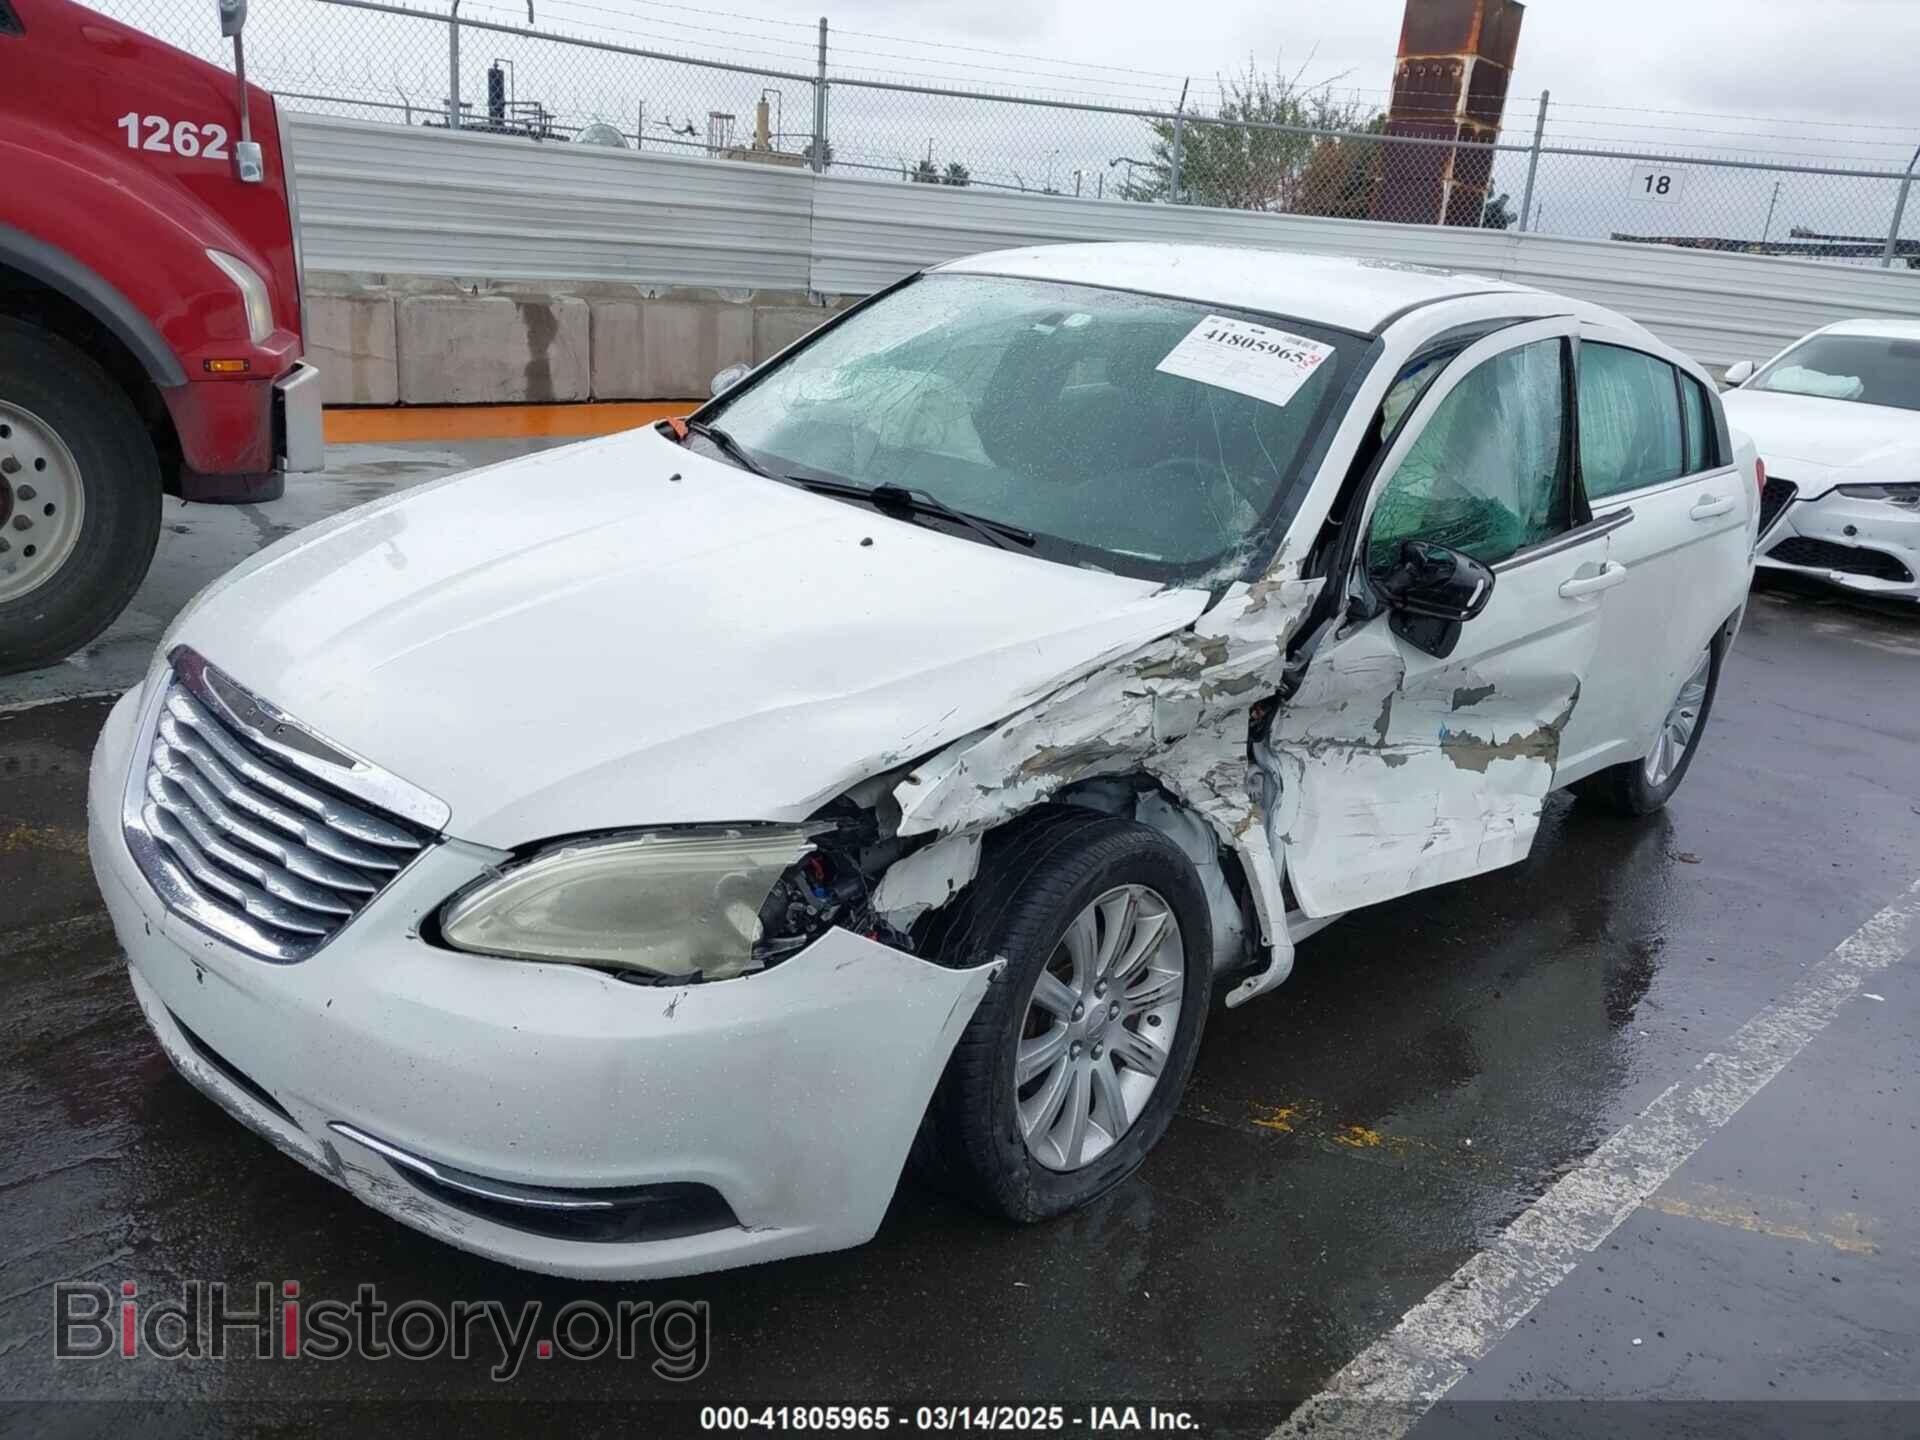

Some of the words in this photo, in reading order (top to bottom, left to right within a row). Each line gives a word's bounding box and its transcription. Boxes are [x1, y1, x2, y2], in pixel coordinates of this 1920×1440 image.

[118, 112, 229, 160] 1262
[1644, 174, 1671, 194] 18
[1203, 329, 1306, 364] 41805965
